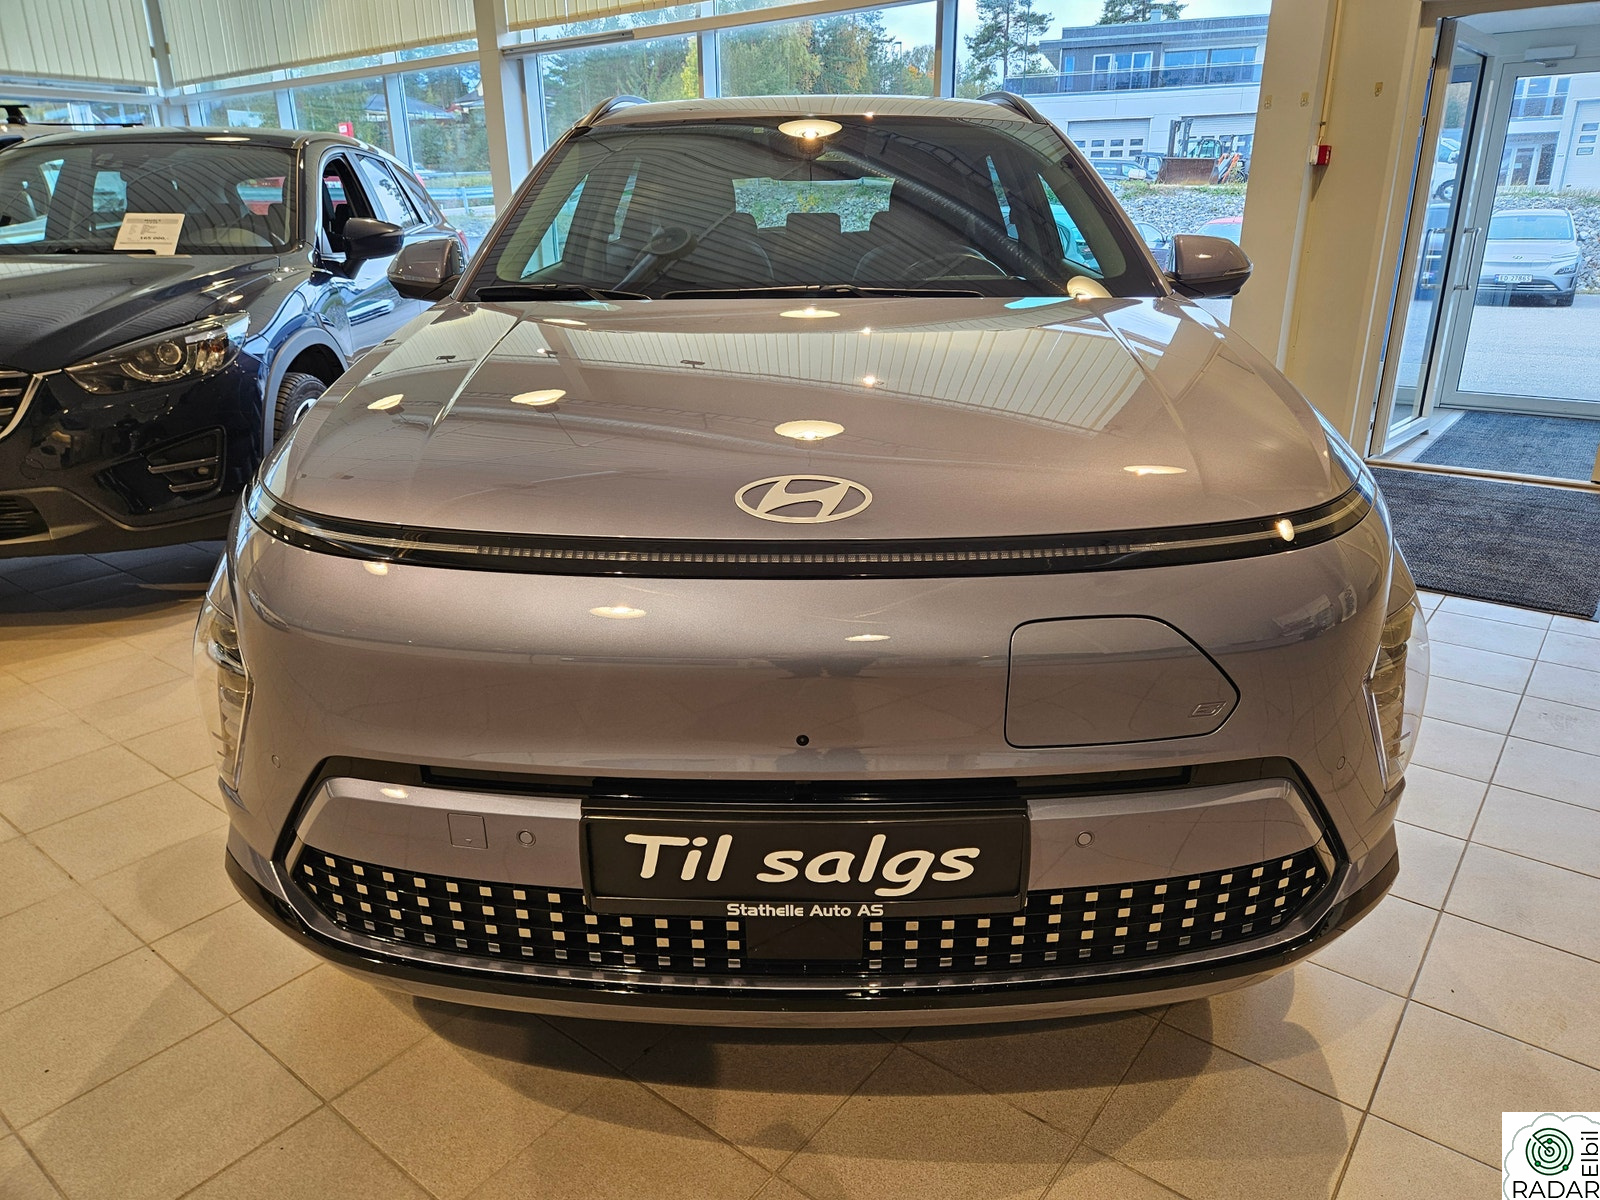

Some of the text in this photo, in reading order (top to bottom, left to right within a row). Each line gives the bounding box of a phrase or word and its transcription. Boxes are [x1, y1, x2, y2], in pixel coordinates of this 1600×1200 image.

[624, 833, 981, 897] Til salgs
[726, 903, 884, 918] Stathelle Auto AS
